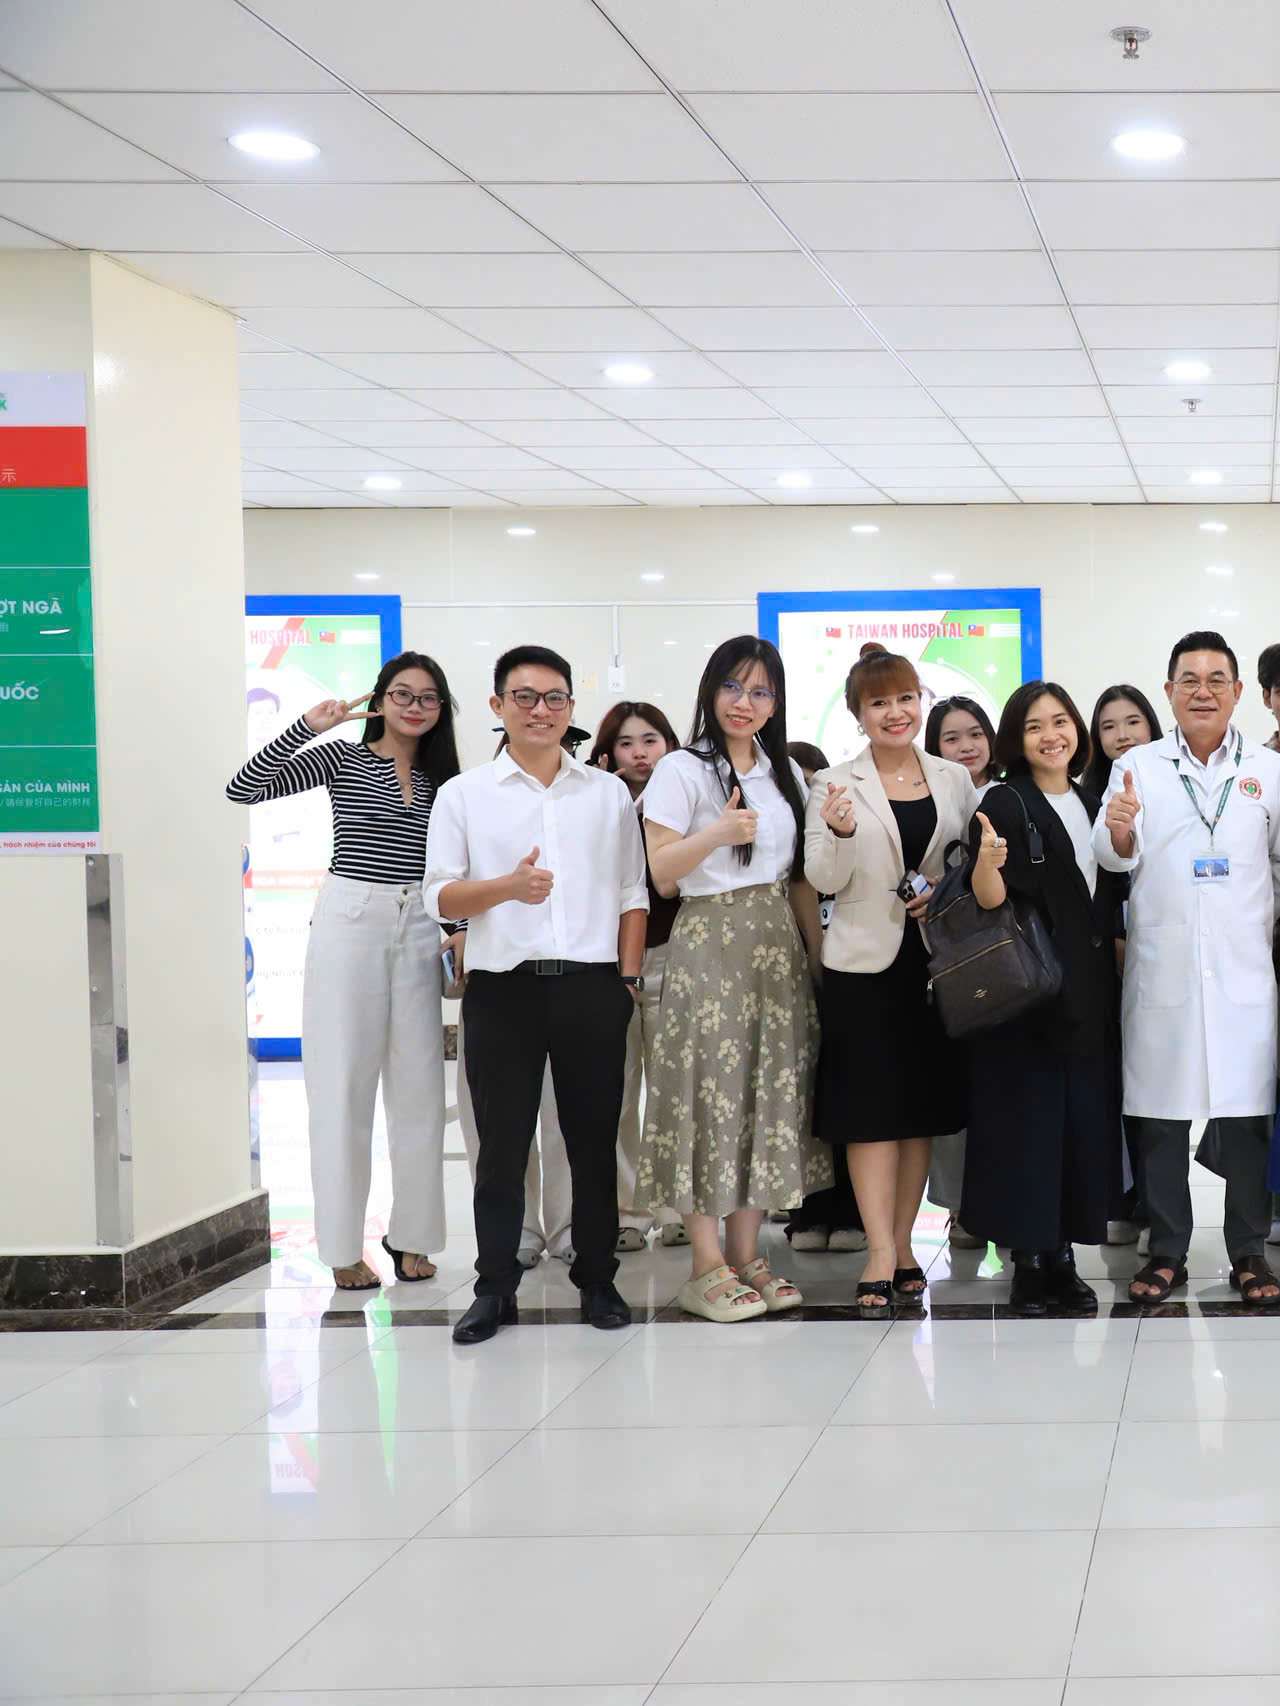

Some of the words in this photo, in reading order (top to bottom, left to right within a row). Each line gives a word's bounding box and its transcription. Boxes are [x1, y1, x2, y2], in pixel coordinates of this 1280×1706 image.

[250, 629, 312, 646] HOSPITAL
[848, 623, 897, 639] TAIWAN
[902, 622, 964, 638] HOSPITAL
[25, 780, 53, 793] CỦA
[57, 780, 90, 793] MÌNH
